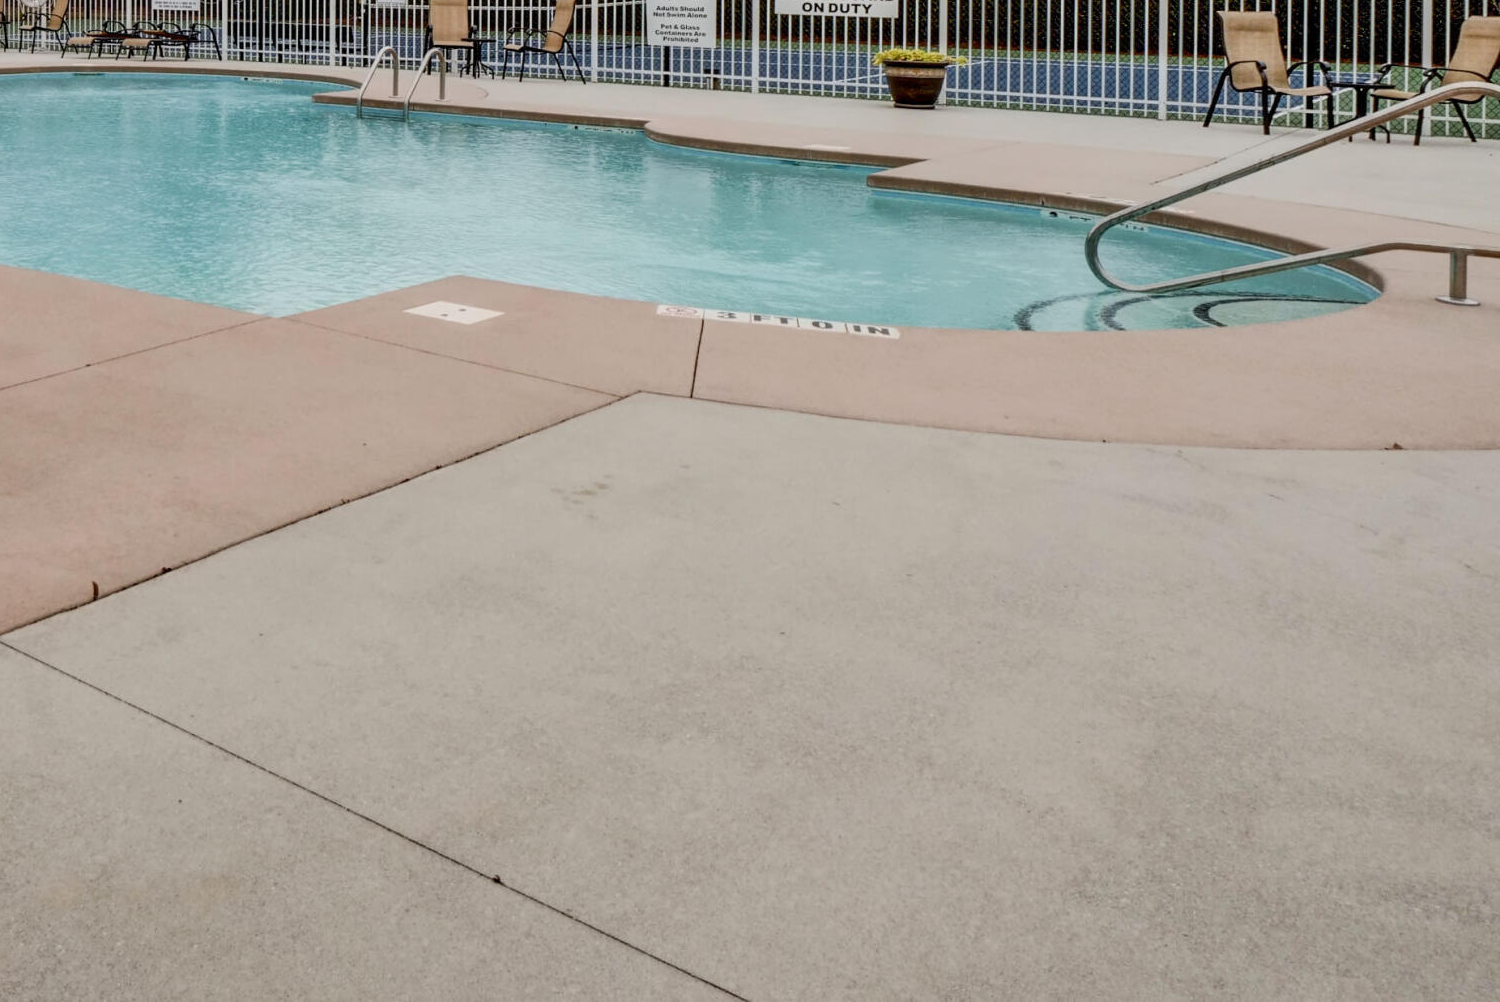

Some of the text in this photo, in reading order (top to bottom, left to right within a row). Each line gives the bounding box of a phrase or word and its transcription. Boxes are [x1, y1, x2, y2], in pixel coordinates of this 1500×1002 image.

[802, 2, 873, 14] ON DUTY
[753, 314, 793, 324] FT
[853, 324, 891, 336] IN
